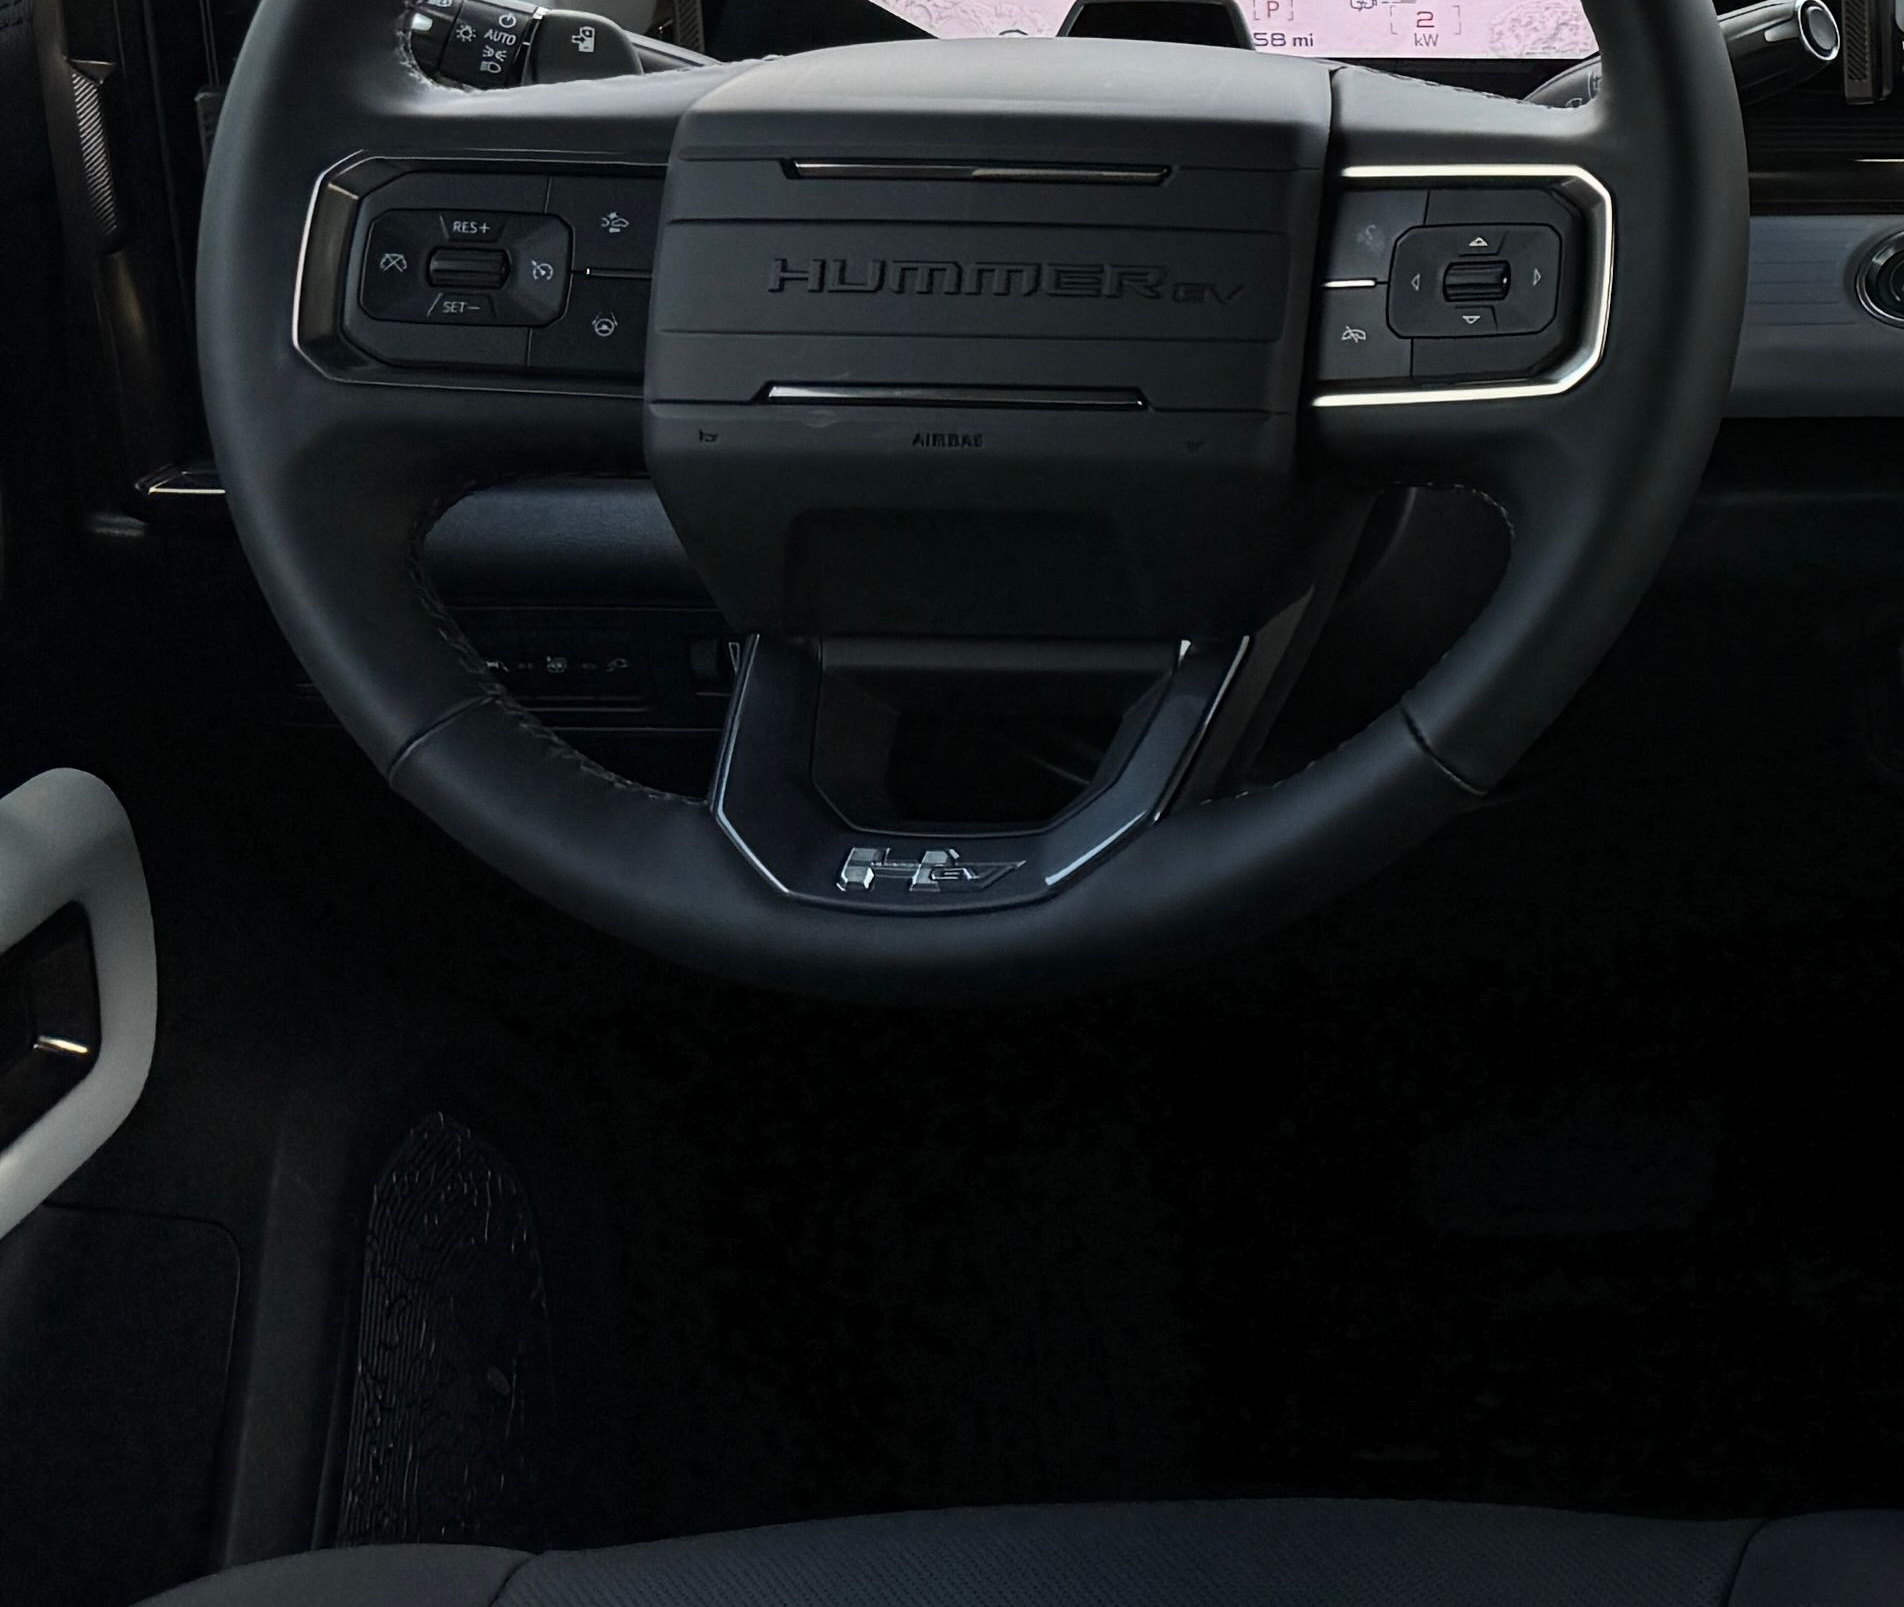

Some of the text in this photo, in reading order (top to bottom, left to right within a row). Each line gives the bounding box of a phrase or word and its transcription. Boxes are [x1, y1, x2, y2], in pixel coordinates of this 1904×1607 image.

[1266, 0, 1280, 18] P
[1416, 10, 1435, 28] 2
[484, 28, 517, 46] AUTO
[1292, 33, 1314, 47] mi
[1414, 33, 1439, 47] kW
[453, 221, 491, 234] RES+
[767, 257, 1169, 302] HUMMER
[911, 431, 984, 449] AIRBAG
